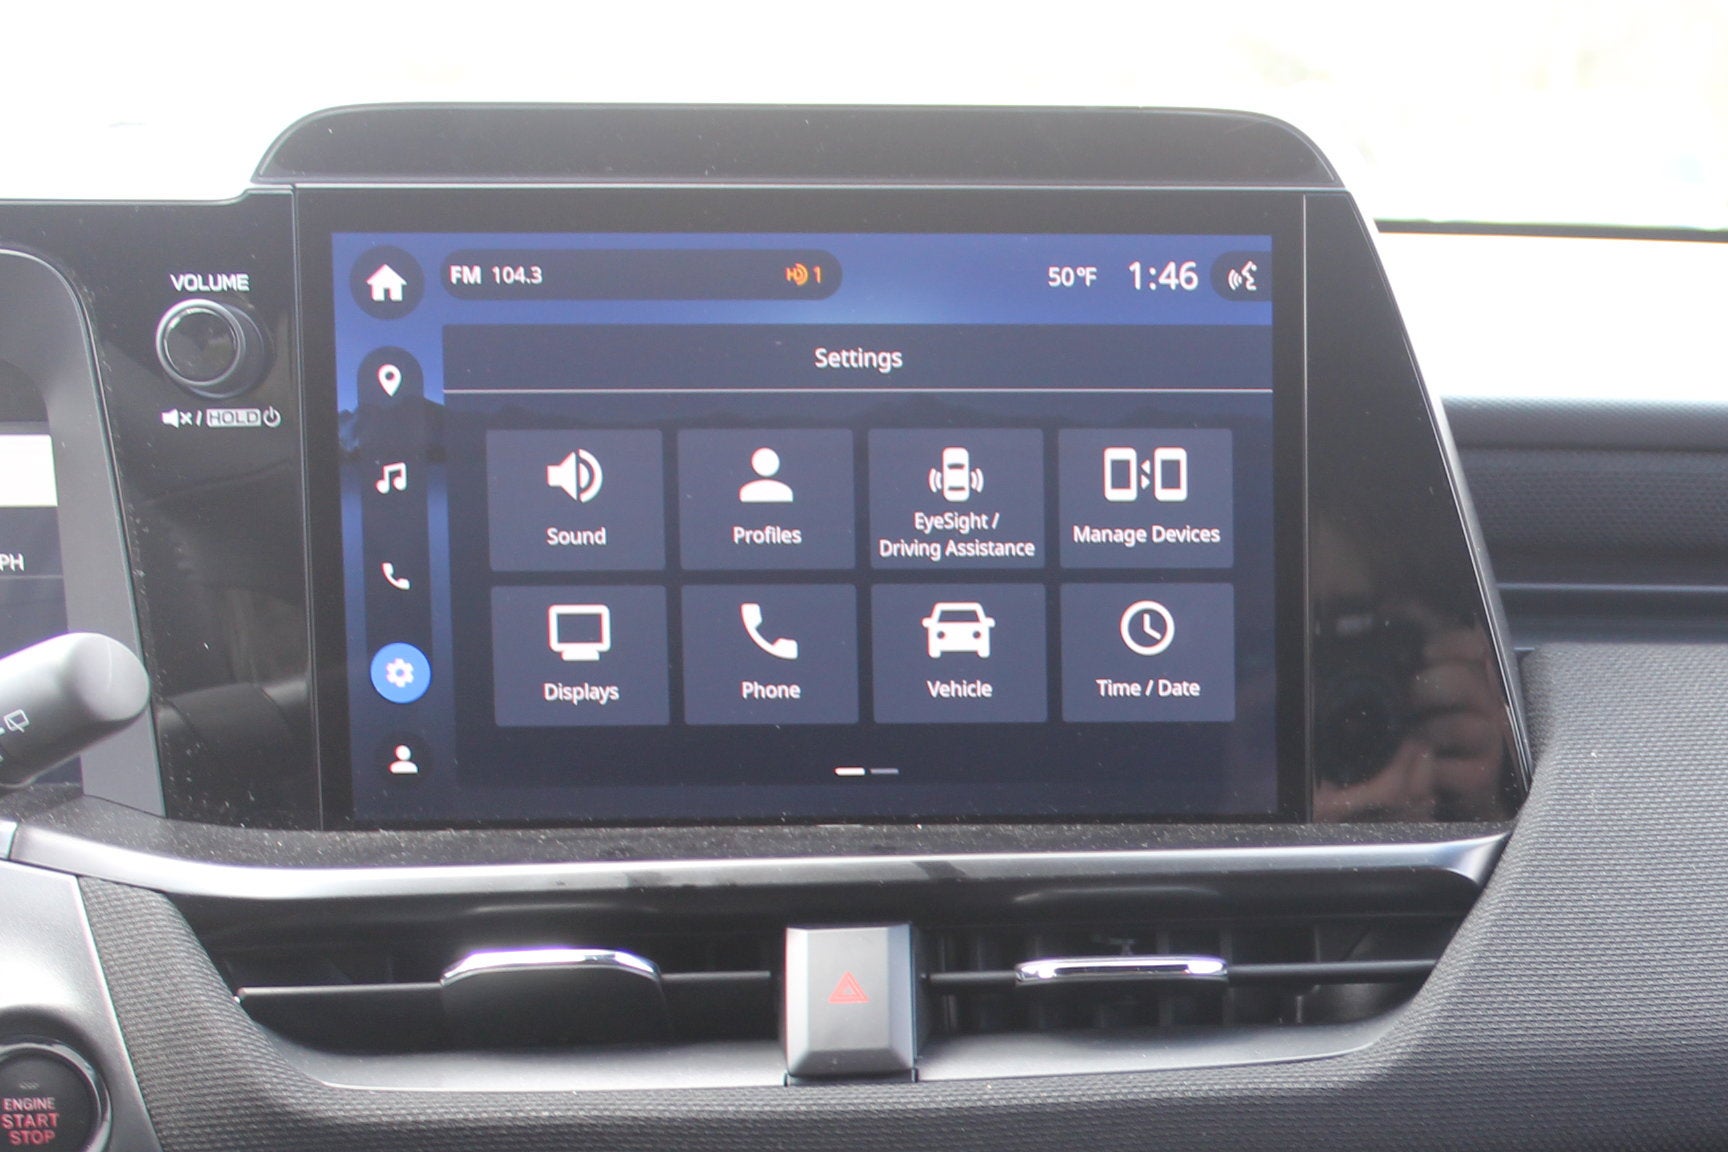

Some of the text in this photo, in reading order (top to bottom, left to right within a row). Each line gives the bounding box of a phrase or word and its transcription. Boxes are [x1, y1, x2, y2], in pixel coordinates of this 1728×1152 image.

[170, 274, 249, 291] VOLUME
[450, 266, 542, 284] FM 104.3
[1130, 262, 1198, 290] 1:46
[815, 348, 902, 373] Settings
[208, 410, 260, 426] HOLD
[915, 512, 988, 534] EyeSight
[547, 527, 606, 545] Sound
[734, 526, 802, 543] Profiles
[1074, 525, 1220, 547] Manage Devices
[880, 539, 1035, 561] Driving Assistance
[544, 683, 619, 704] Displays
[742, 682, 801, 698] Phone
[927, 680, 992, 697] Vehicle
[1096, 680, 1139, 697] Time
[1158, 679, 1200, 696] Date
[3, 1097, 55, 1111] ENGINE
[1, 1113, 59, 1129] START
[9, 1130, 55, 1145] STOP
